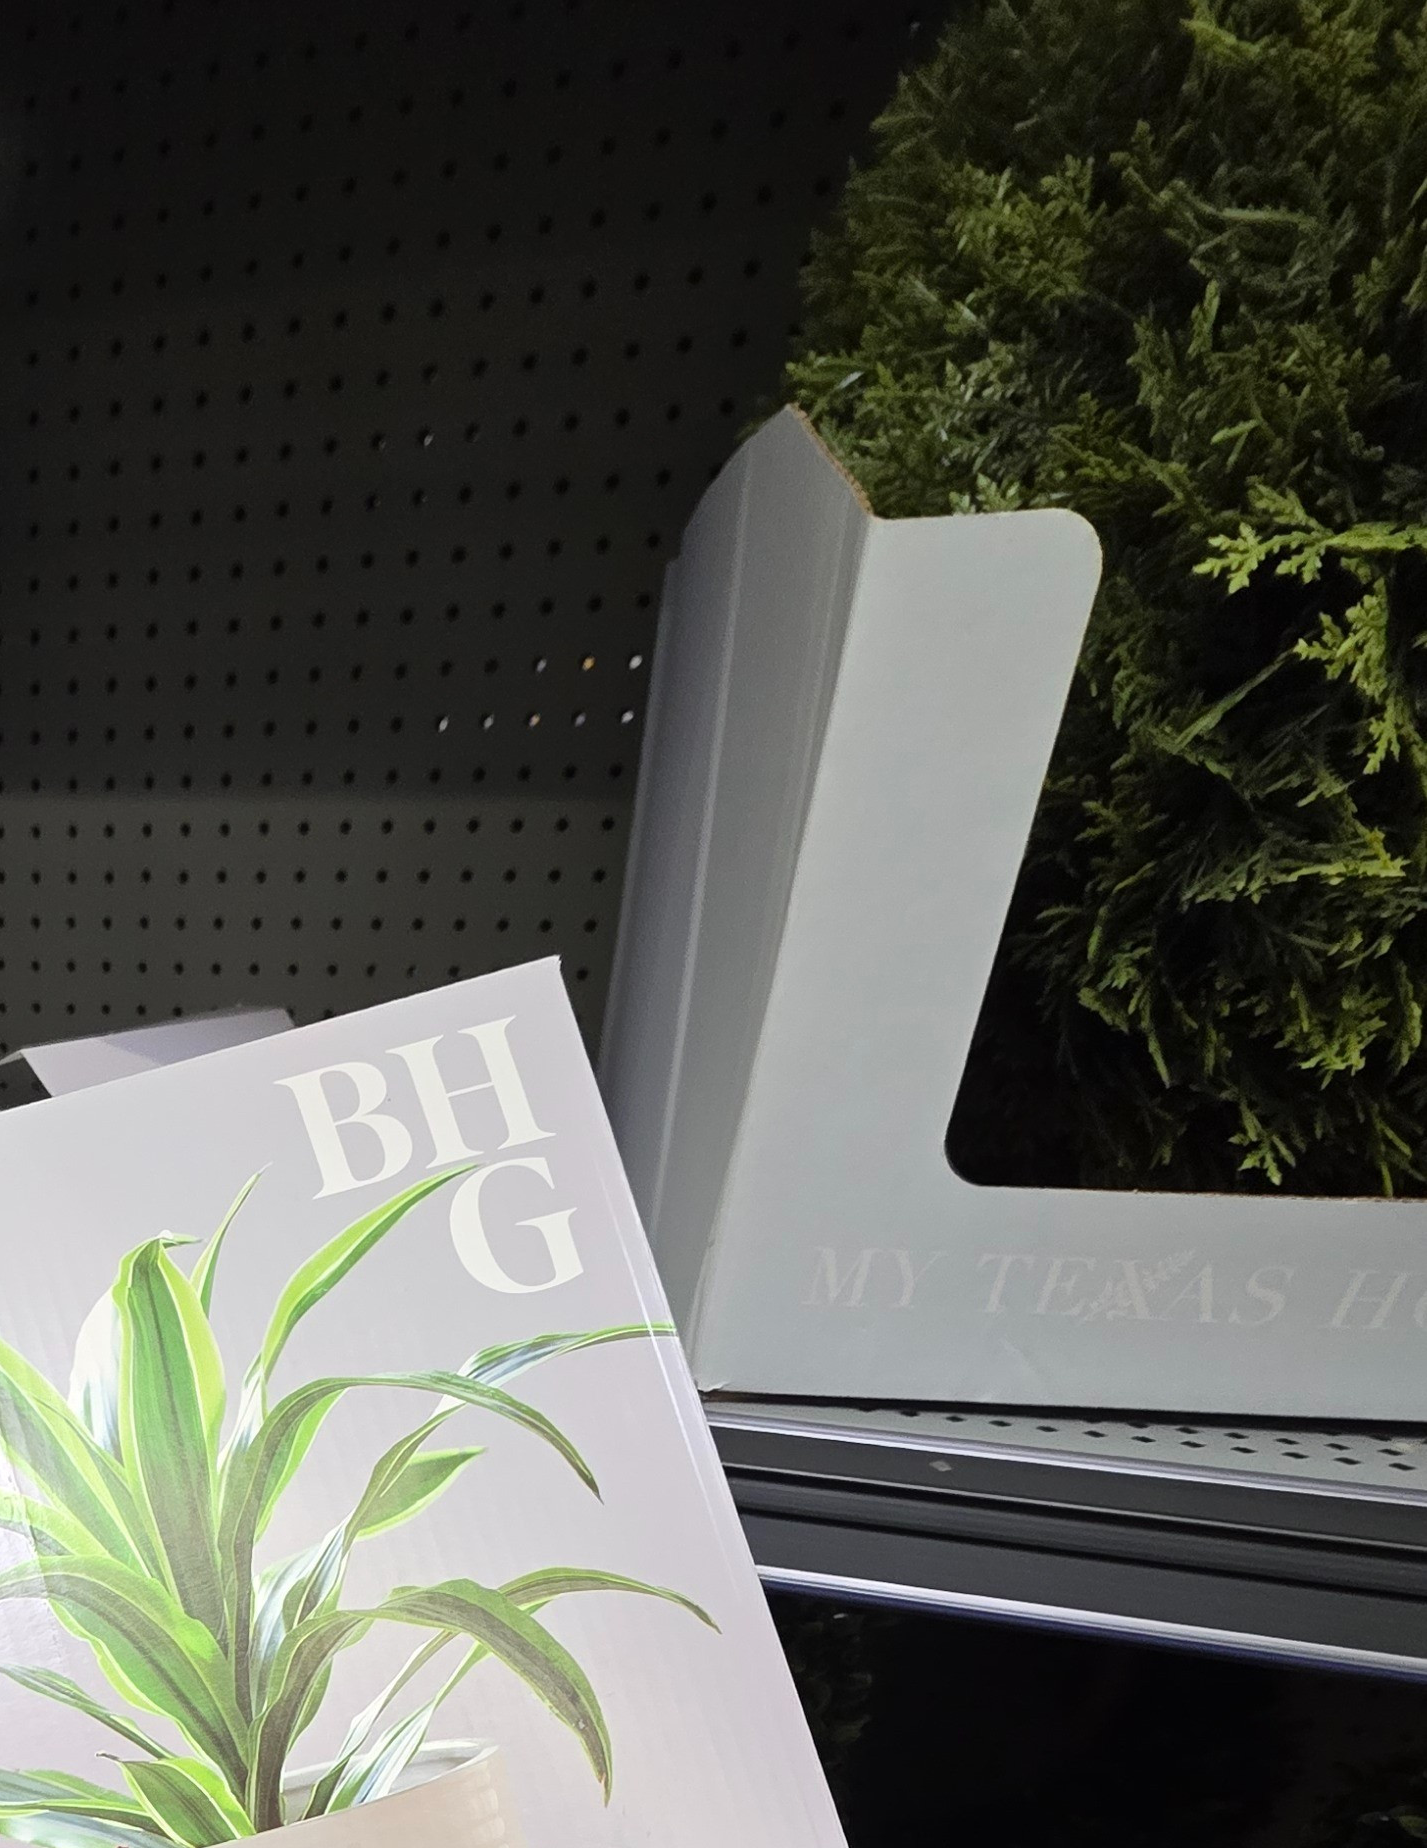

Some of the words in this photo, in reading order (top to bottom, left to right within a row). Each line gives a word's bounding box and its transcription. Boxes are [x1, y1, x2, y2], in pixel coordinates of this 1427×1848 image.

[800, 1246, 946, 1310] MY
[976, 1248, 1296, 1328] TEXAS
[1319, 1268, 1427, 1331] H
